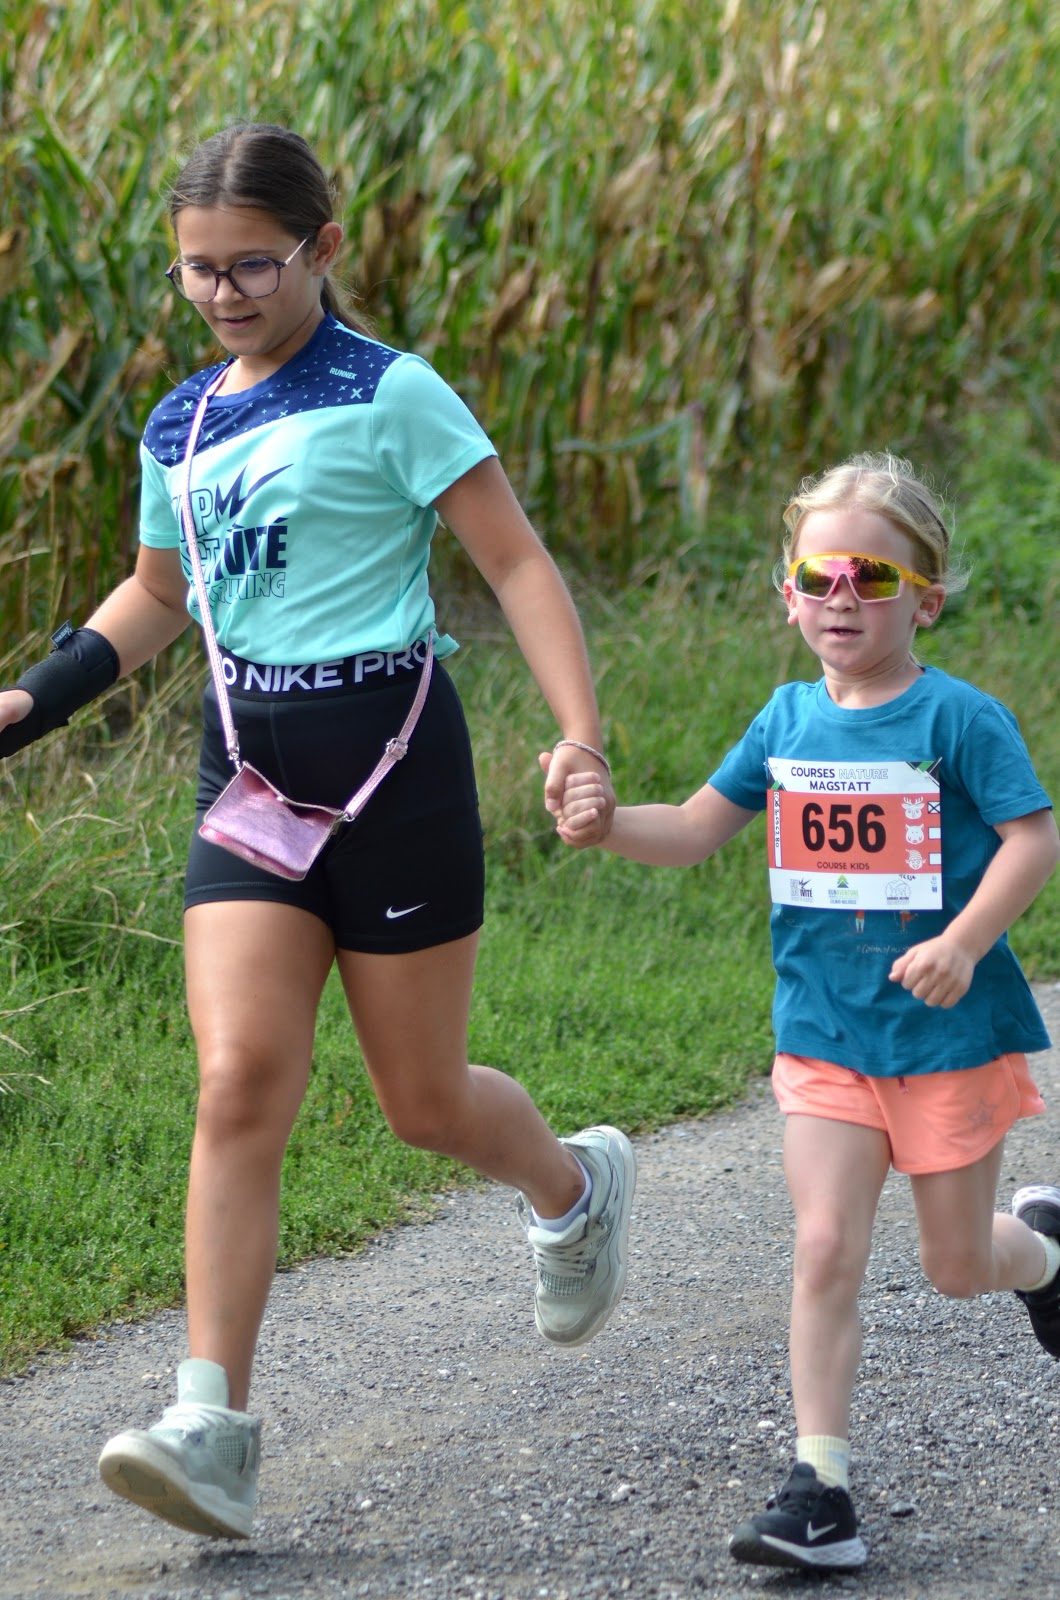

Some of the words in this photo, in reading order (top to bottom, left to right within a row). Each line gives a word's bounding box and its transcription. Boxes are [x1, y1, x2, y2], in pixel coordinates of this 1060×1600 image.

[244, 659, 346, 692] NIKE
[791, 766, 835, 779] COURSES
[838, 768, 889, 780] NATURE
[809, 781, 871, 792] MAGSTATT
[801, 802, 887, 853] 656
[817, 861, 847, 870] COURSE
[850, 862, 870, 870] KIDS
